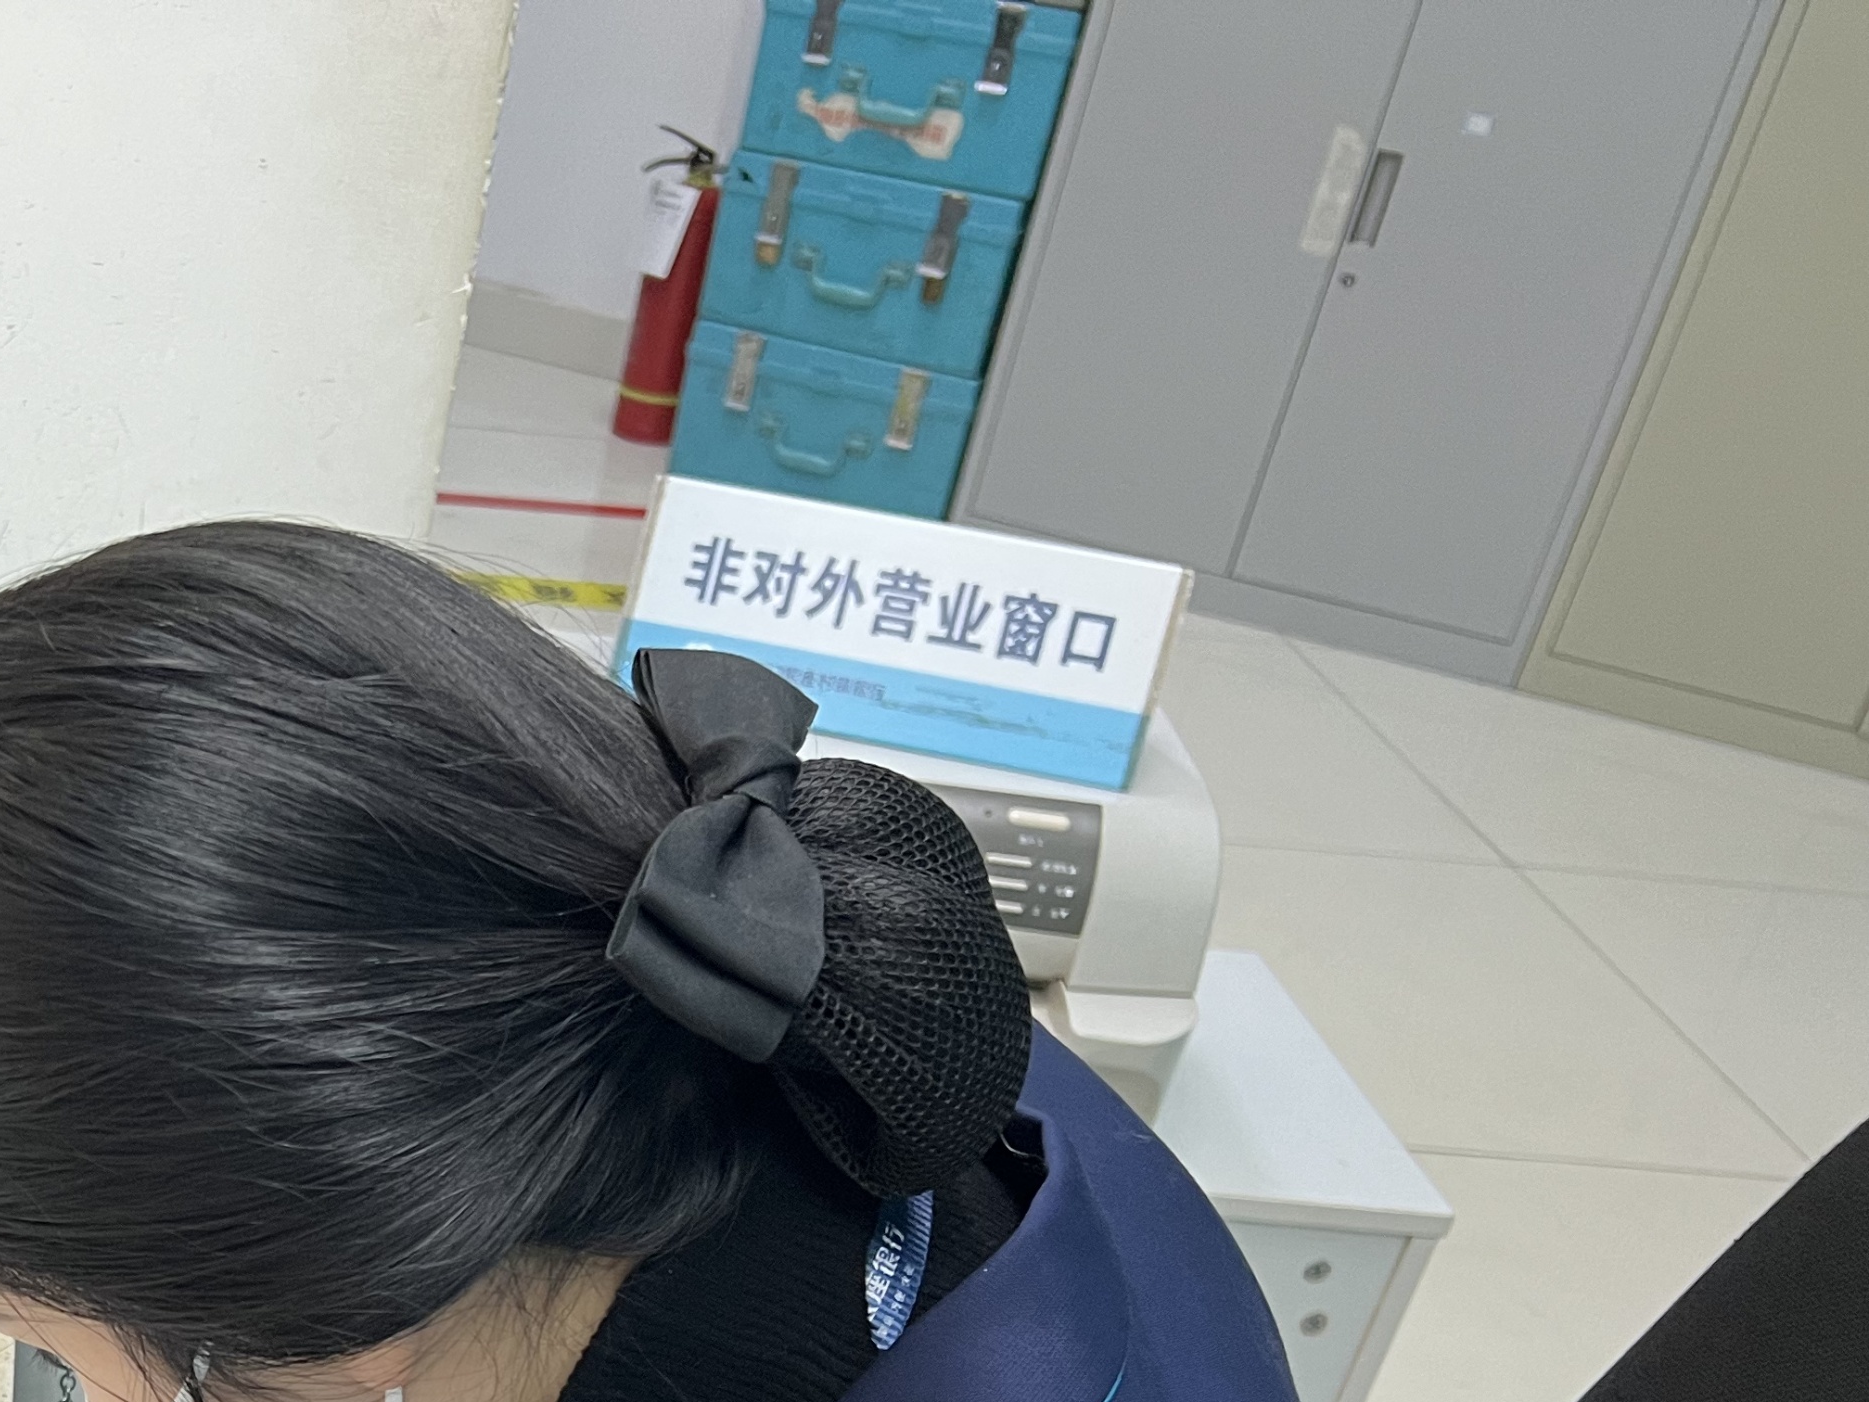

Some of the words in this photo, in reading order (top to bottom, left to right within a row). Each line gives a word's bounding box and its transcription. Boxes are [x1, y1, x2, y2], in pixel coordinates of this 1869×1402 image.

[683, 536, 1118, 673] 非对外营业窗口
